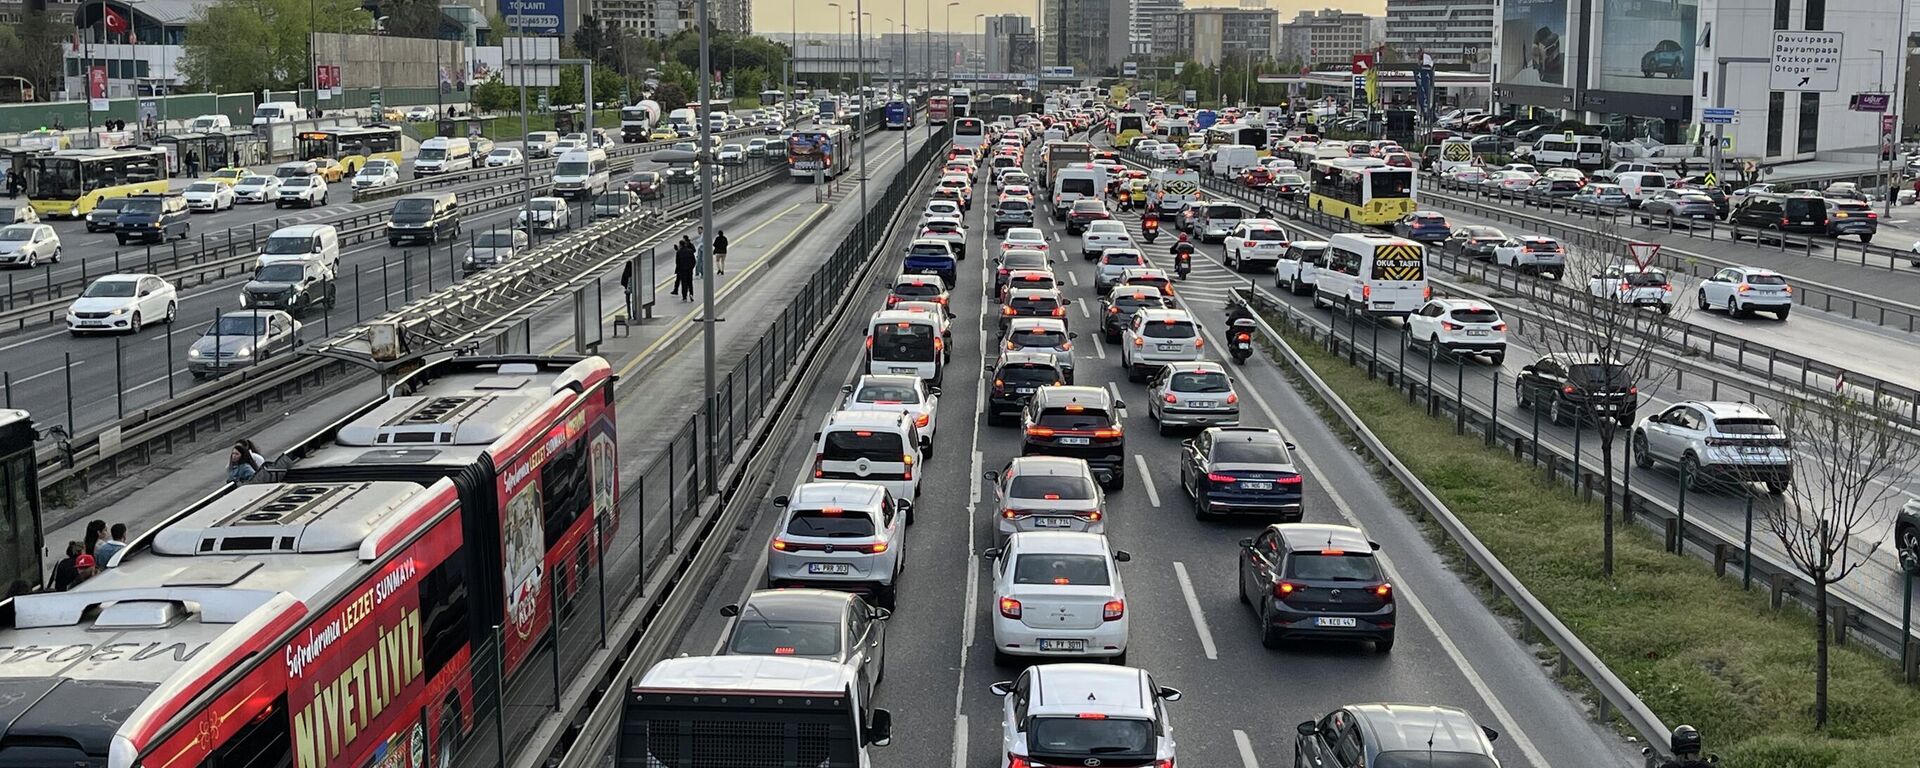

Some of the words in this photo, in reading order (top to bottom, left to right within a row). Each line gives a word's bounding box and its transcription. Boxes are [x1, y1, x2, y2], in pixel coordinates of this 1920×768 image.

[1777, 34, 1834, 44] Davutpaşa
[1776, 45, 1838, 54] Bayrampaşa
[1776, 55, 1837, 64] Tozkoparan
[1774, 64, 1811, 74] Otogar
[1399, 260, 1420, 268] TAŞITI
[286, 627, 341, 679] Sofralarınıza
[341, 587, 375, 634] LEZZET
[376, 557, 416, 605] SUNMAYA
[1043, 641, 1052, 649] 34
[0, 641, 211, 664] M304
[294, 606, 423, 768] NİYETLİYİZ
